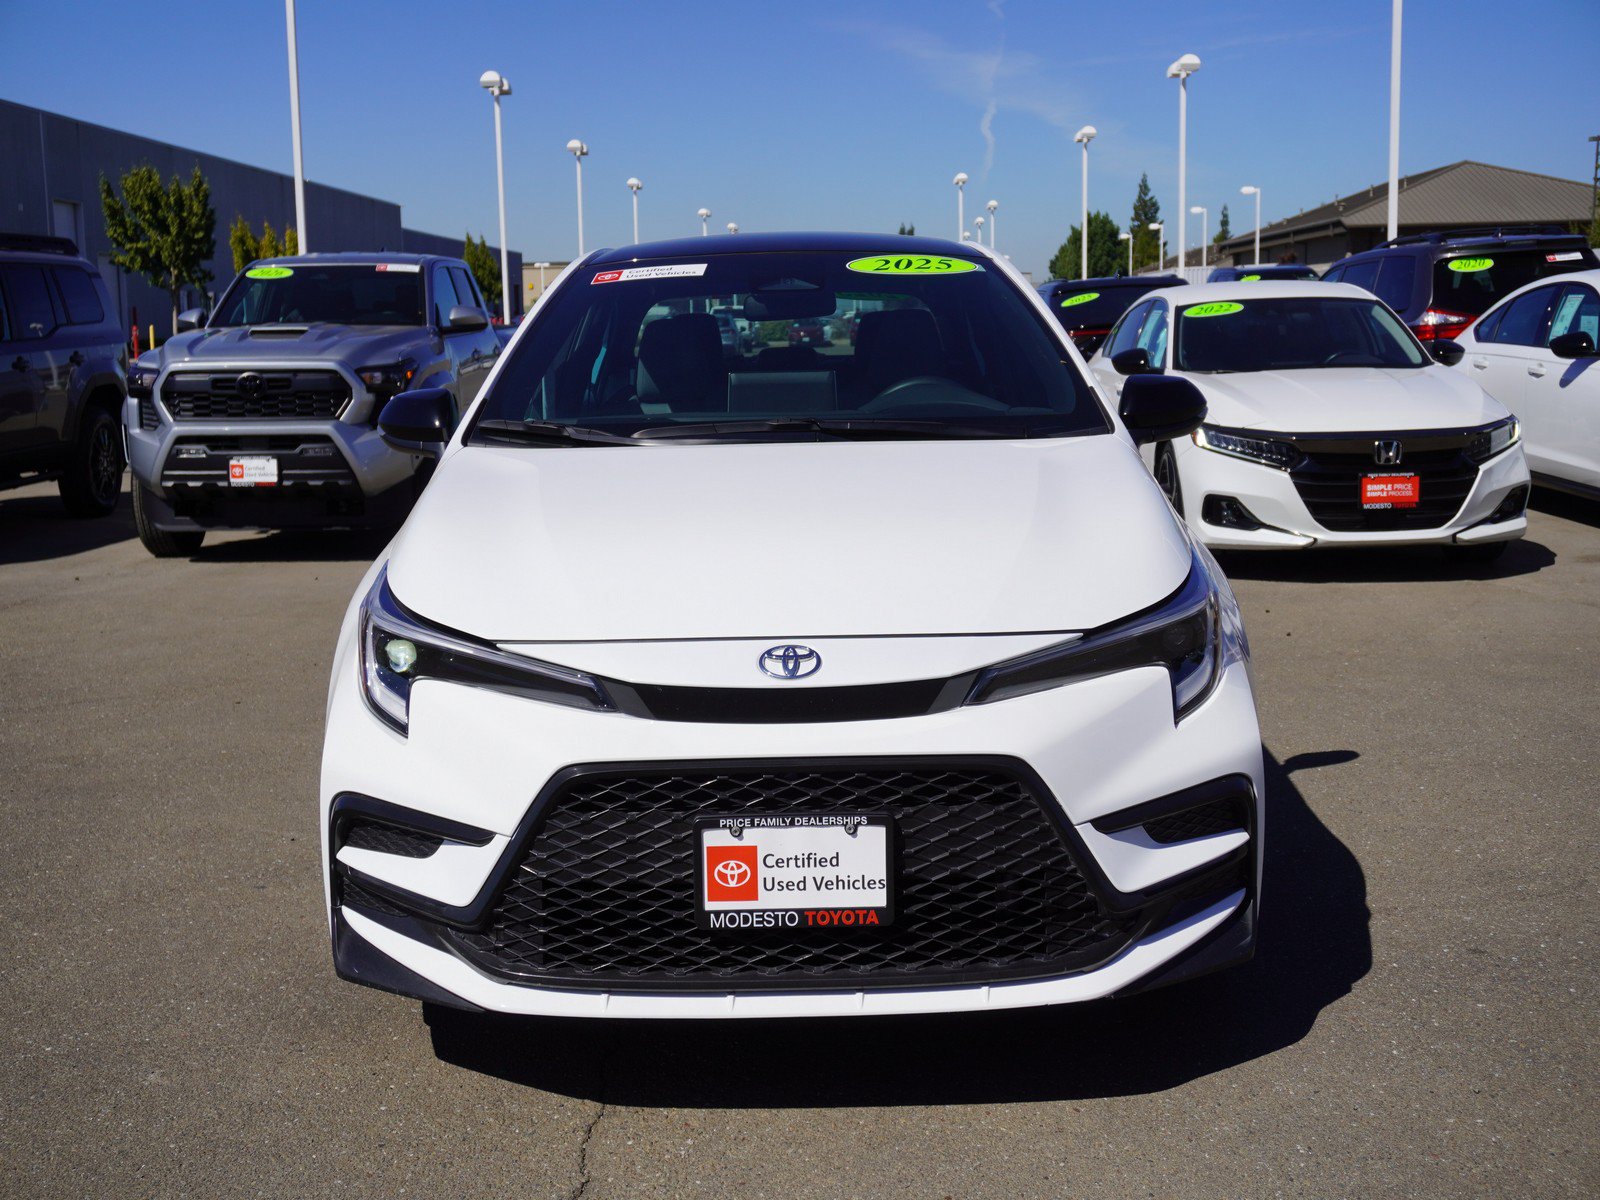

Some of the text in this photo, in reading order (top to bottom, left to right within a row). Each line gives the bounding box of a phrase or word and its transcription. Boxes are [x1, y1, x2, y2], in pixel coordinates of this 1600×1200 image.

[873, 258, 953, 271] 2025
[1456, 259, 1486, 269] 2020
[1195, 303, 1233, 315] 2022
[719, 816, 868, 828] PRICE FAMILY DEALERSHIPS
[762, 852, 840, 869] Certified
[763, 874, 886, 892] Used Vehicles
[710, 909, 879, 928] MODESTO TOYOTA
